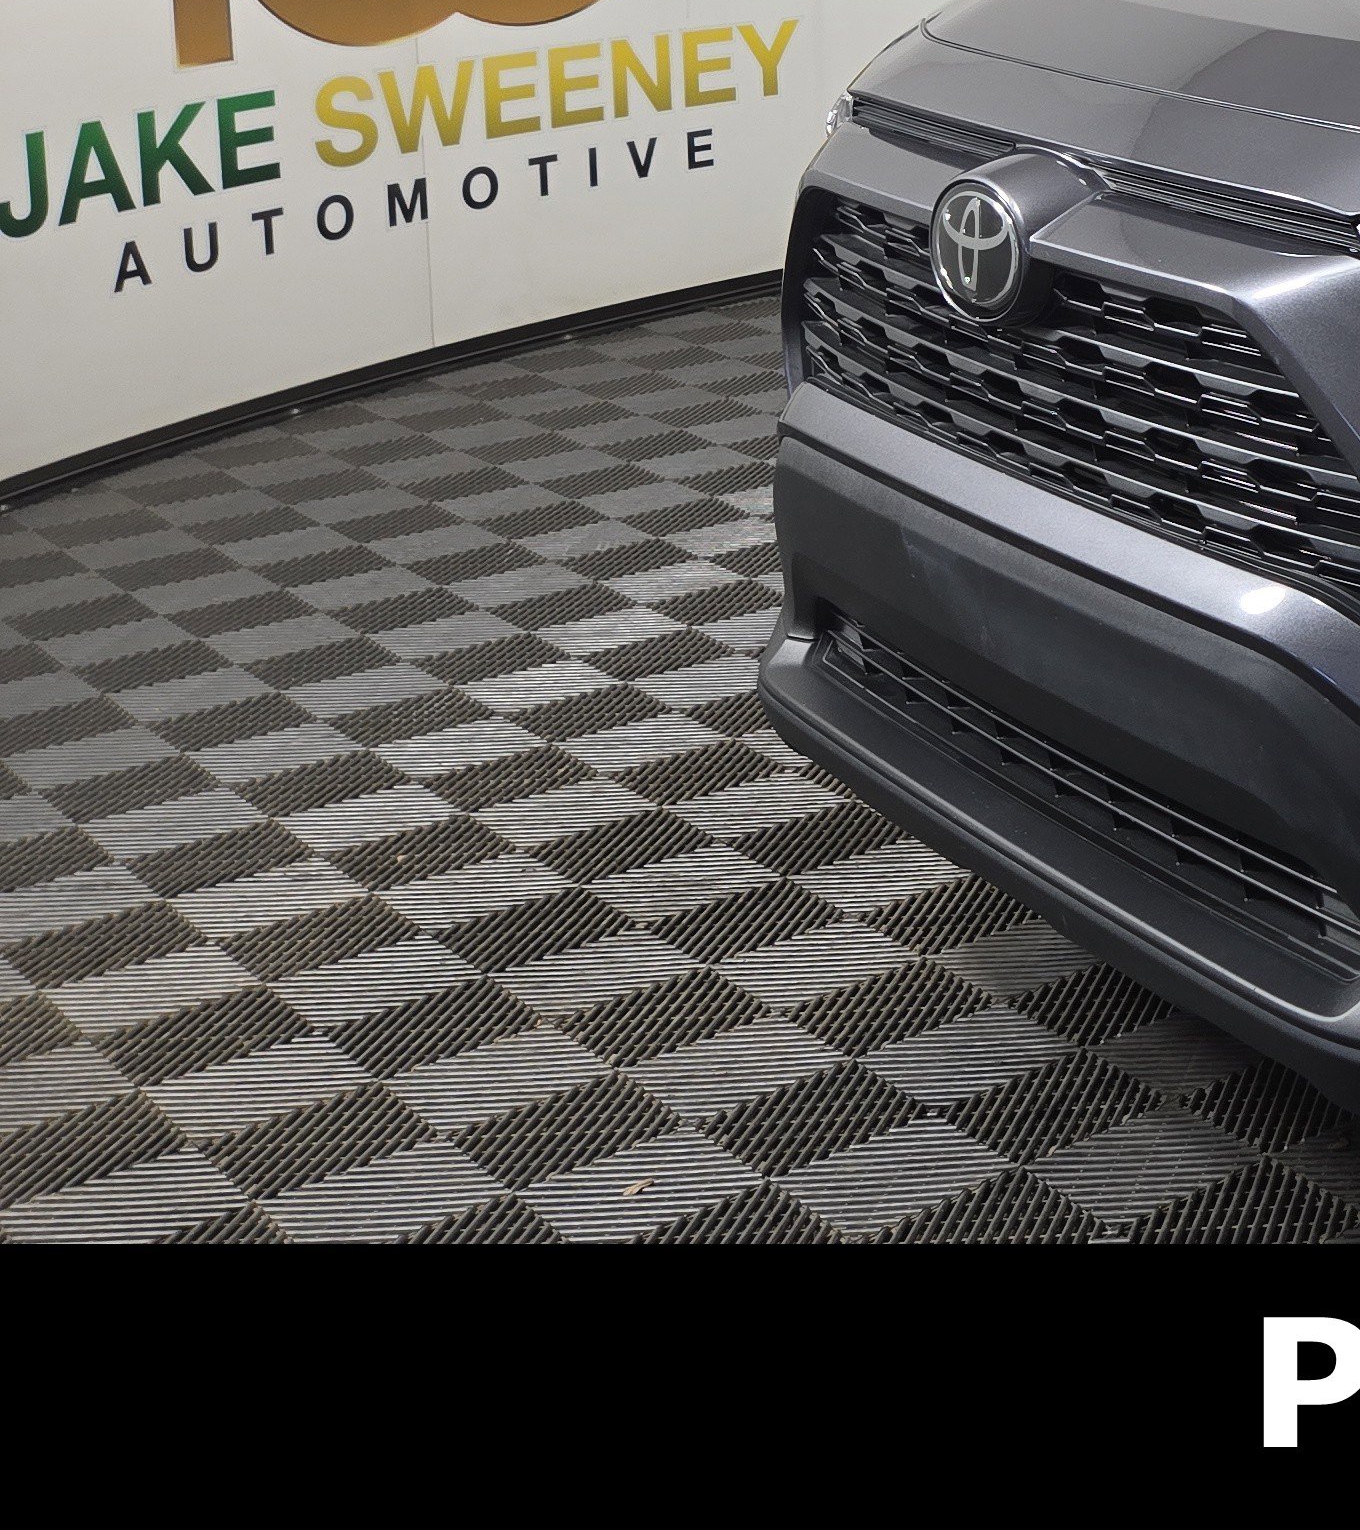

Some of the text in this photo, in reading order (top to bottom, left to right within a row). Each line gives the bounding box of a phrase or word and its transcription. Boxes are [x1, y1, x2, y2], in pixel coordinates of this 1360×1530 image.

[0, 19, 800, 239] JAKE SWEENEY
[114, 128, 716, 293] AUTOMOTIVE
